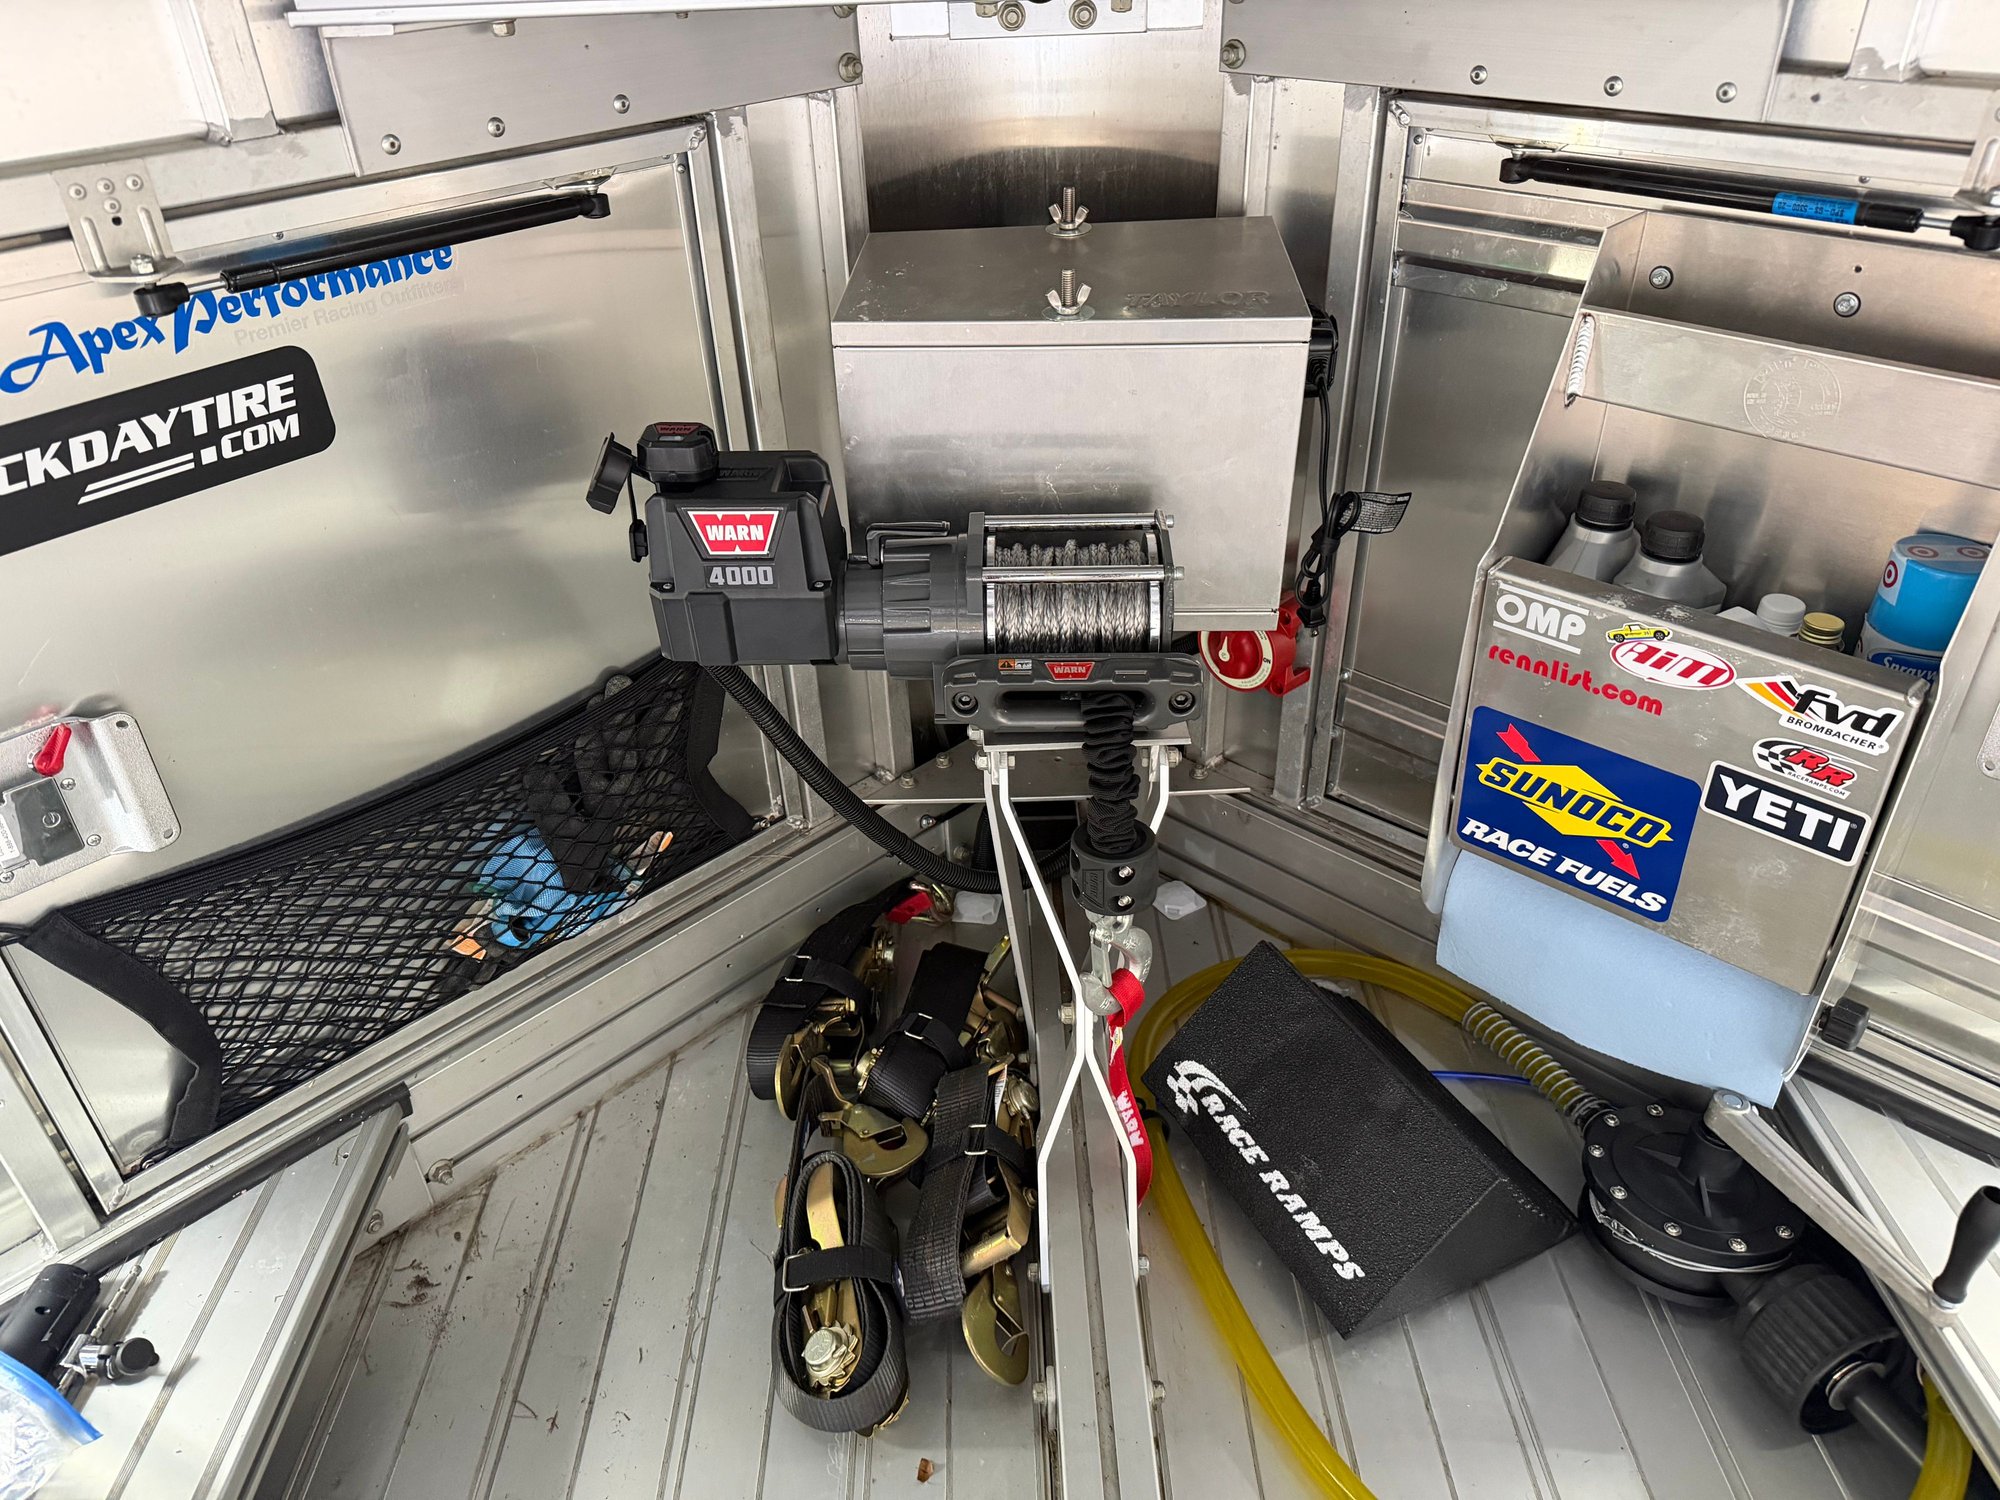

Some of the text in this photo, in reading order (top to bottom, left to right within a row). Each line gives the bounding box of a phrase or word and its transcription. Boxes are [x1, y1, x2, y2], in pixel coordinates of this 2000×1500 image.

[0, 246, 452, 394] Apex Performance
[234, 278, 464, 346] Premier Racing Outfitters
[1125, 291, 1270, 308] TAYLOR
[705, 525, 764, 541] WARN
[709, 566, 774, 585] 4000
[1496, 594, 1587, 642] OMP
[1053, 666, 1086, 674] WARN
[1488, 645, 1663, 716] rennlist.com
[1793, 689, 1896, 738] fvd
[1781, 747, 1855, 787] RR
[1787, 771, 1846, 797] RACERAMPS.COM
[1484, 761, 1665, 843] SUNOCO
[1719, 773, 1851, 851] YETI
[1461, 817, 1667, 912] RACE FUELS
[1116, 1090, 1145, 1147] WARN
[1201, 1093, 1366, 1279] RACE RAMPS
